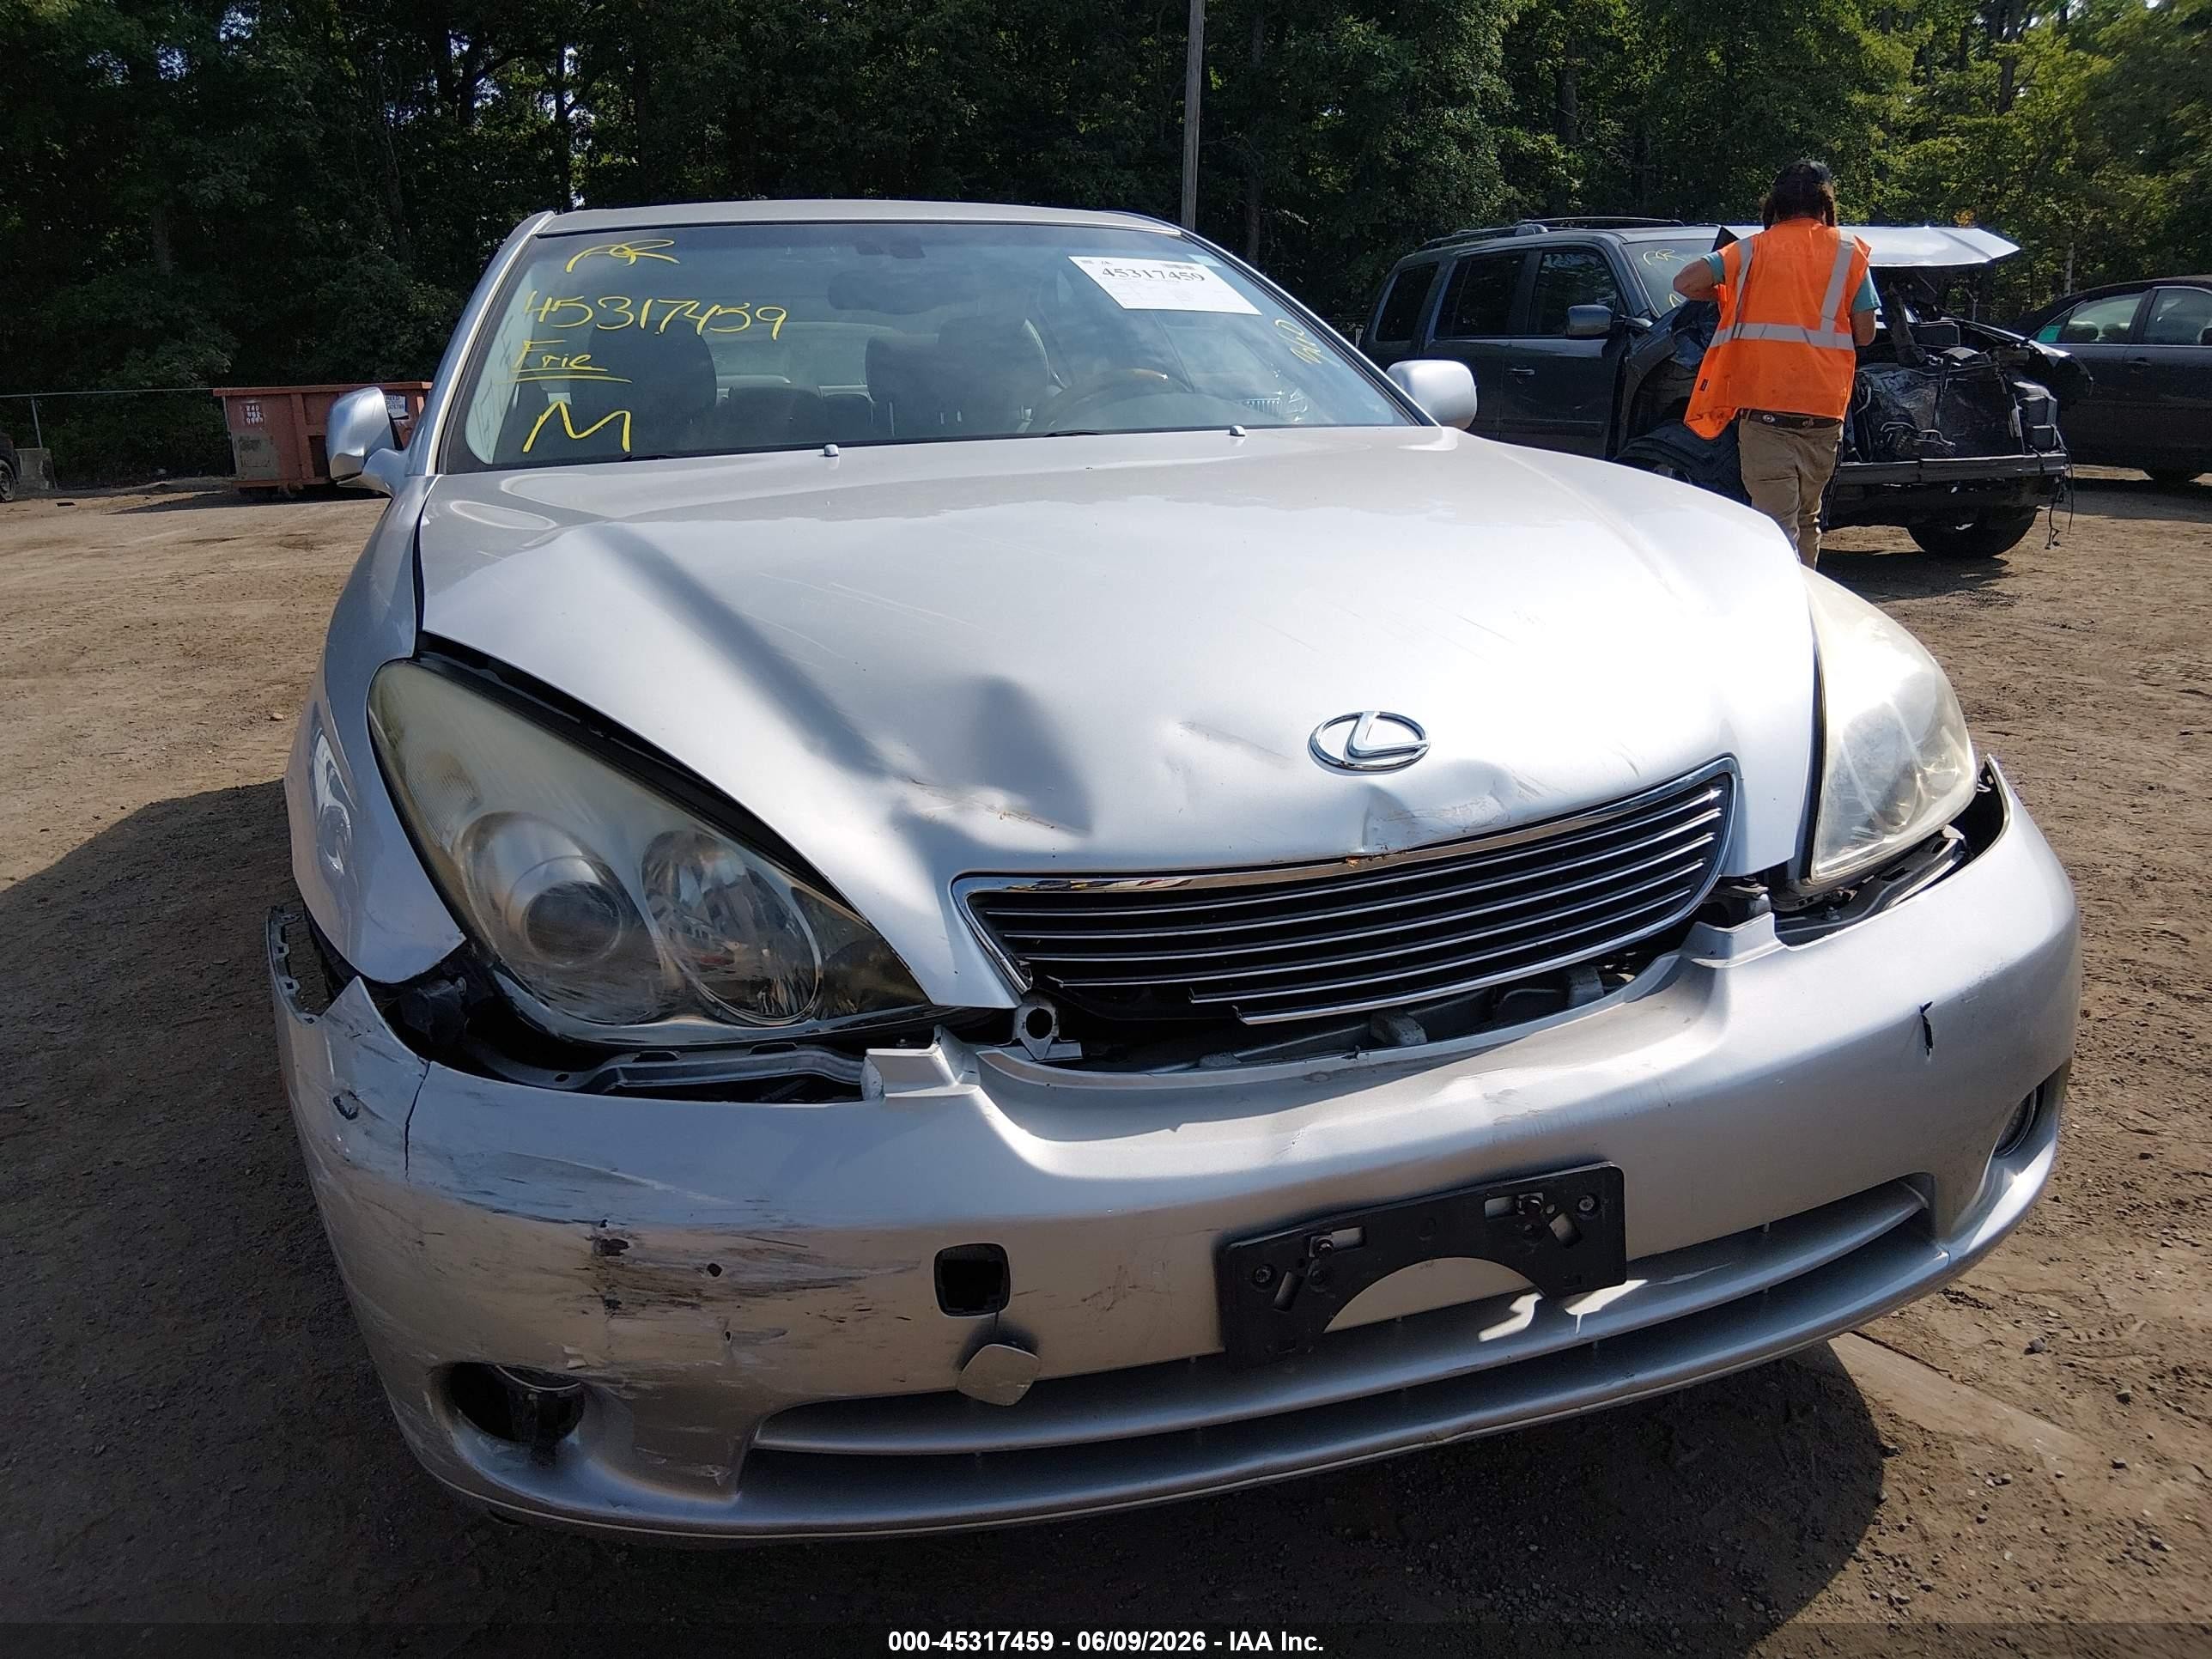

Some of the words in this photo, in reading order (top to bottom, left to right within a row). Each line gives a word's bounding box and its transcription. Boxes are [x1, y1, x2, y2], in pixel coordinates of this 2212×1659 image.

[1102, 267, 1206, 282] 45317459
[524, 290, 787, 340] 45317459
[514, 340, 599, 371] Erie
